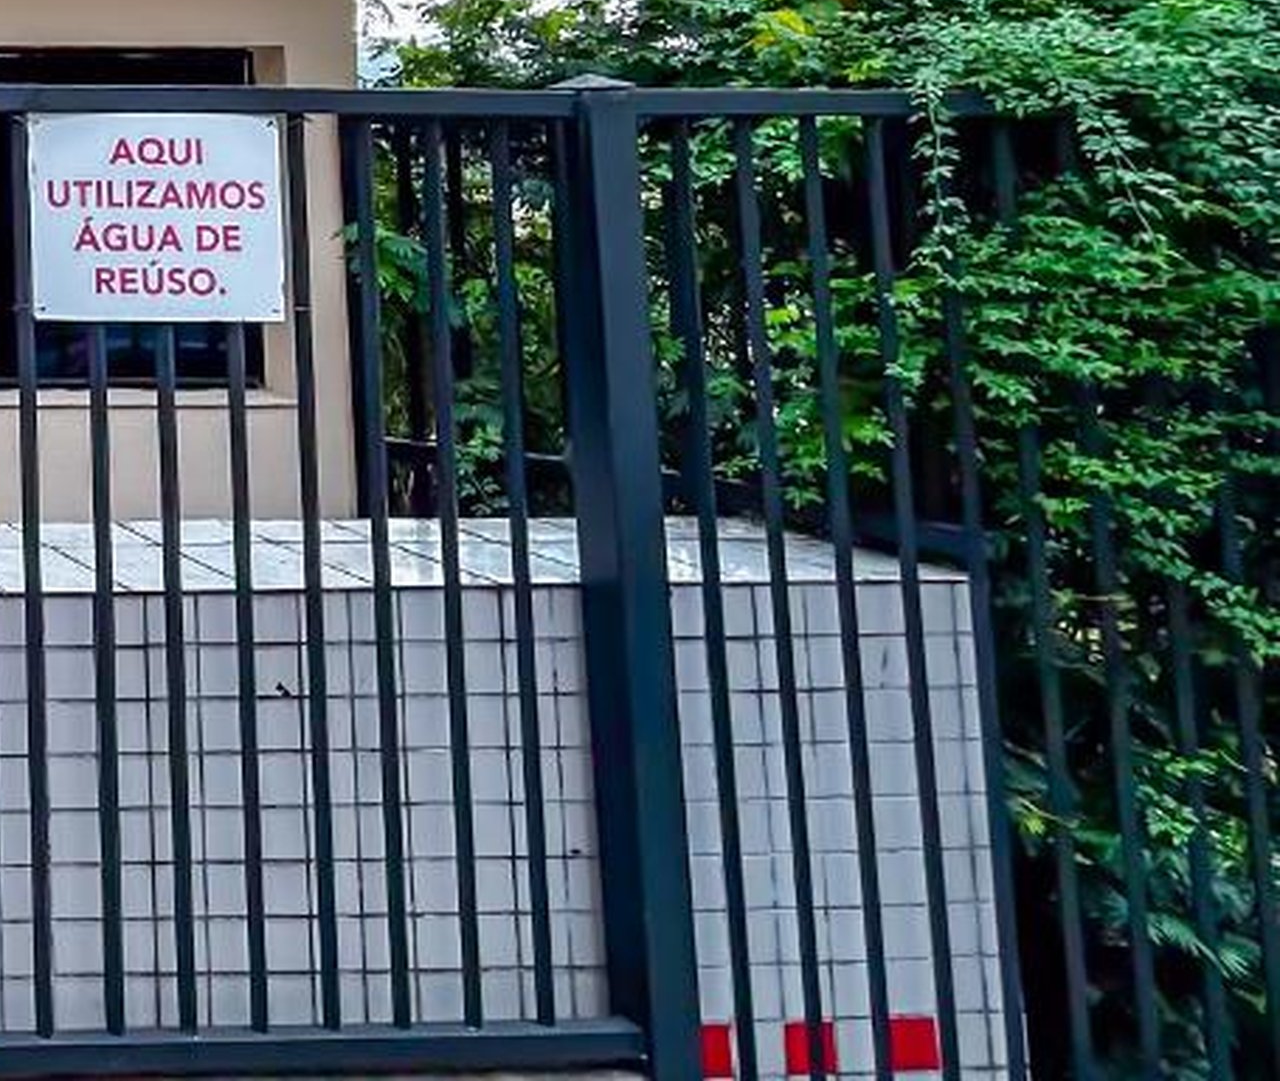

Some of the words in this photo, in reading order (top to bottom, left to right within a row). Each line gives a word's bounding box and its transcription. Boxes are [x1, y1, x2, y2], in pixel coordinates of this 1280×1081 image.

[109, 138, 204, 166] AQUI
[46, 180, 266, 209] UTILIZAMOS
[74, 217, 183, 252] ÁGUA
[196, 225, 242, 252] DE
[95, 260, 227, 295] REÚSO.
